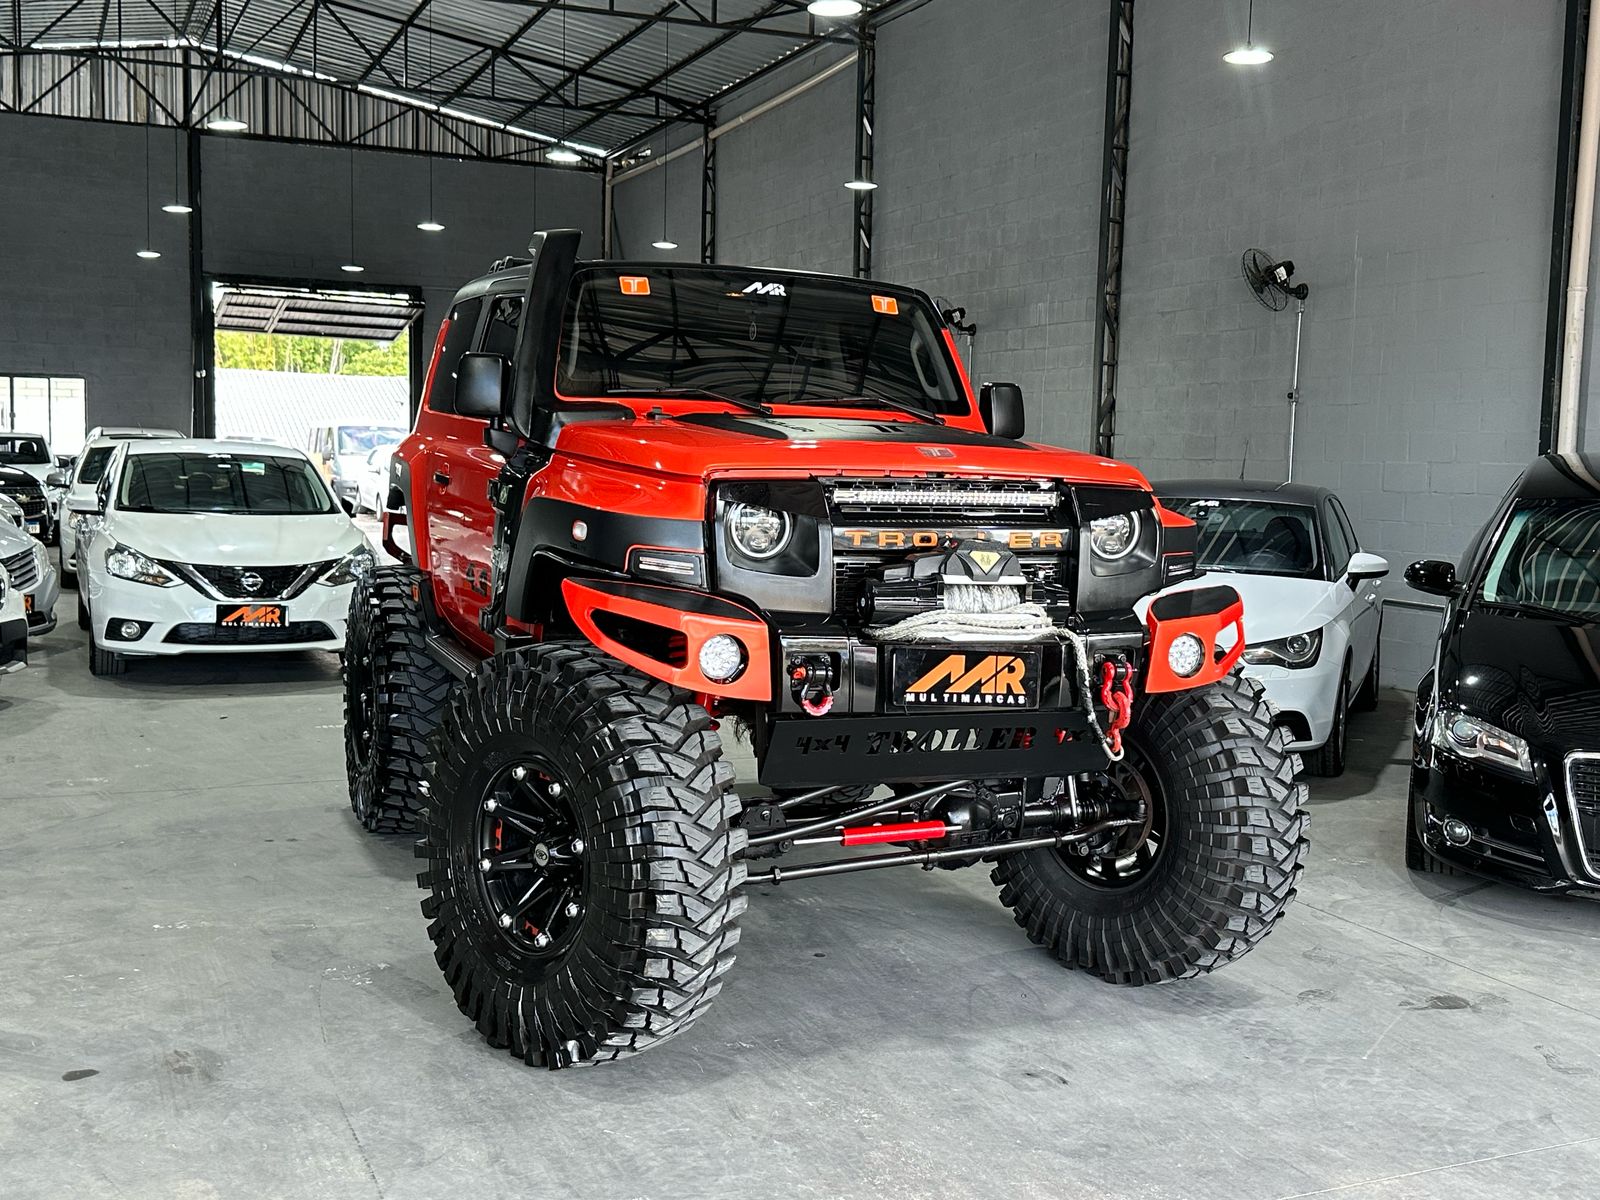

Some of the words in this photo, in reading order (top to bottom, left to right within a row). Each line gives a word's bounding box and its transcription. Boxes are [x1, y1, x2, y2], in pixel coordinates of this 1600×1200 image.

[844, 530, 1063, 549] TROER
[905, 693, 1026, 705] MULTIMARCAS
[866, 727, 1037, 755] TROLLER
